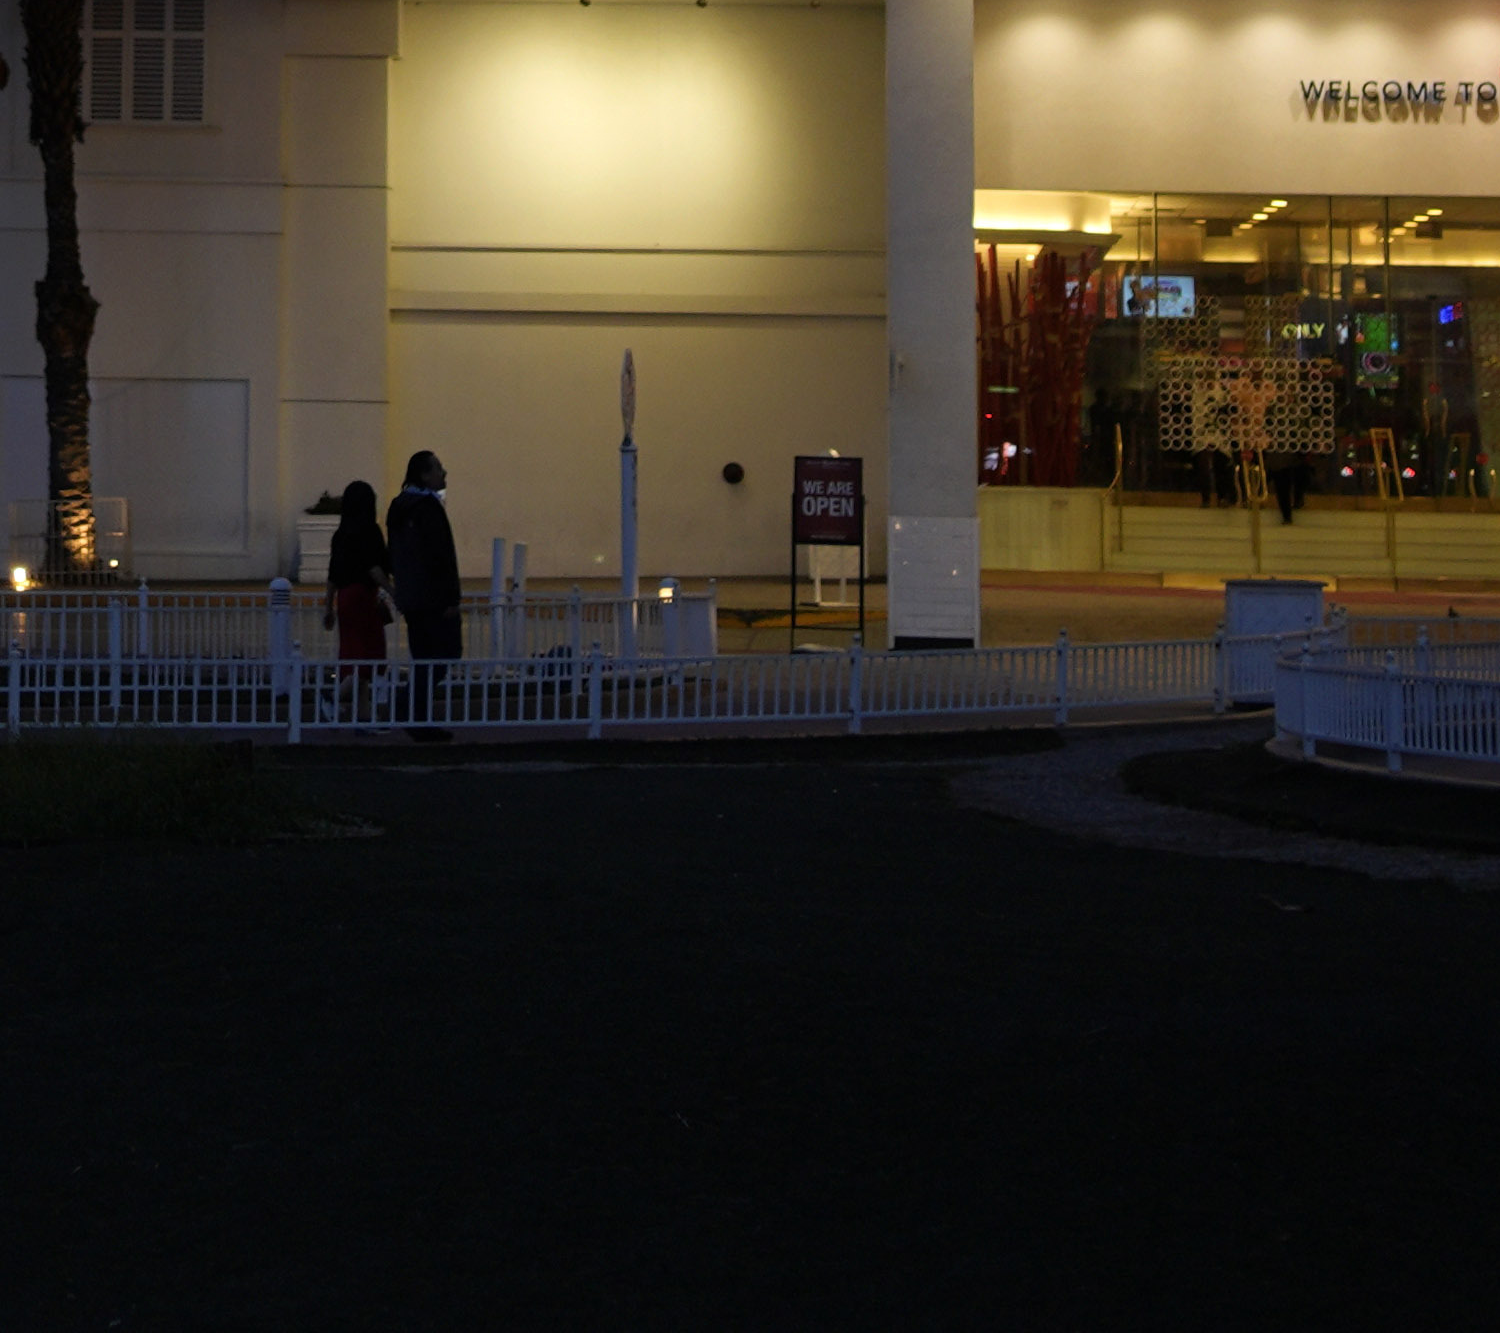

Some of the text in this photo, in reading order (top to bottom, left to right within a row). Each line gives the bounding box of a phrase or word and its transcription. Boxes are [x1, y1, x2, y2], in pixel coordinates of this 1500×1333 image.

[1301, 80, 1447, 102] WELCOME
[1460, 82, 1498, 102] TO
[803, 480, 855, 495] WE ARE
[802, 496, 855, 517] OPEN
